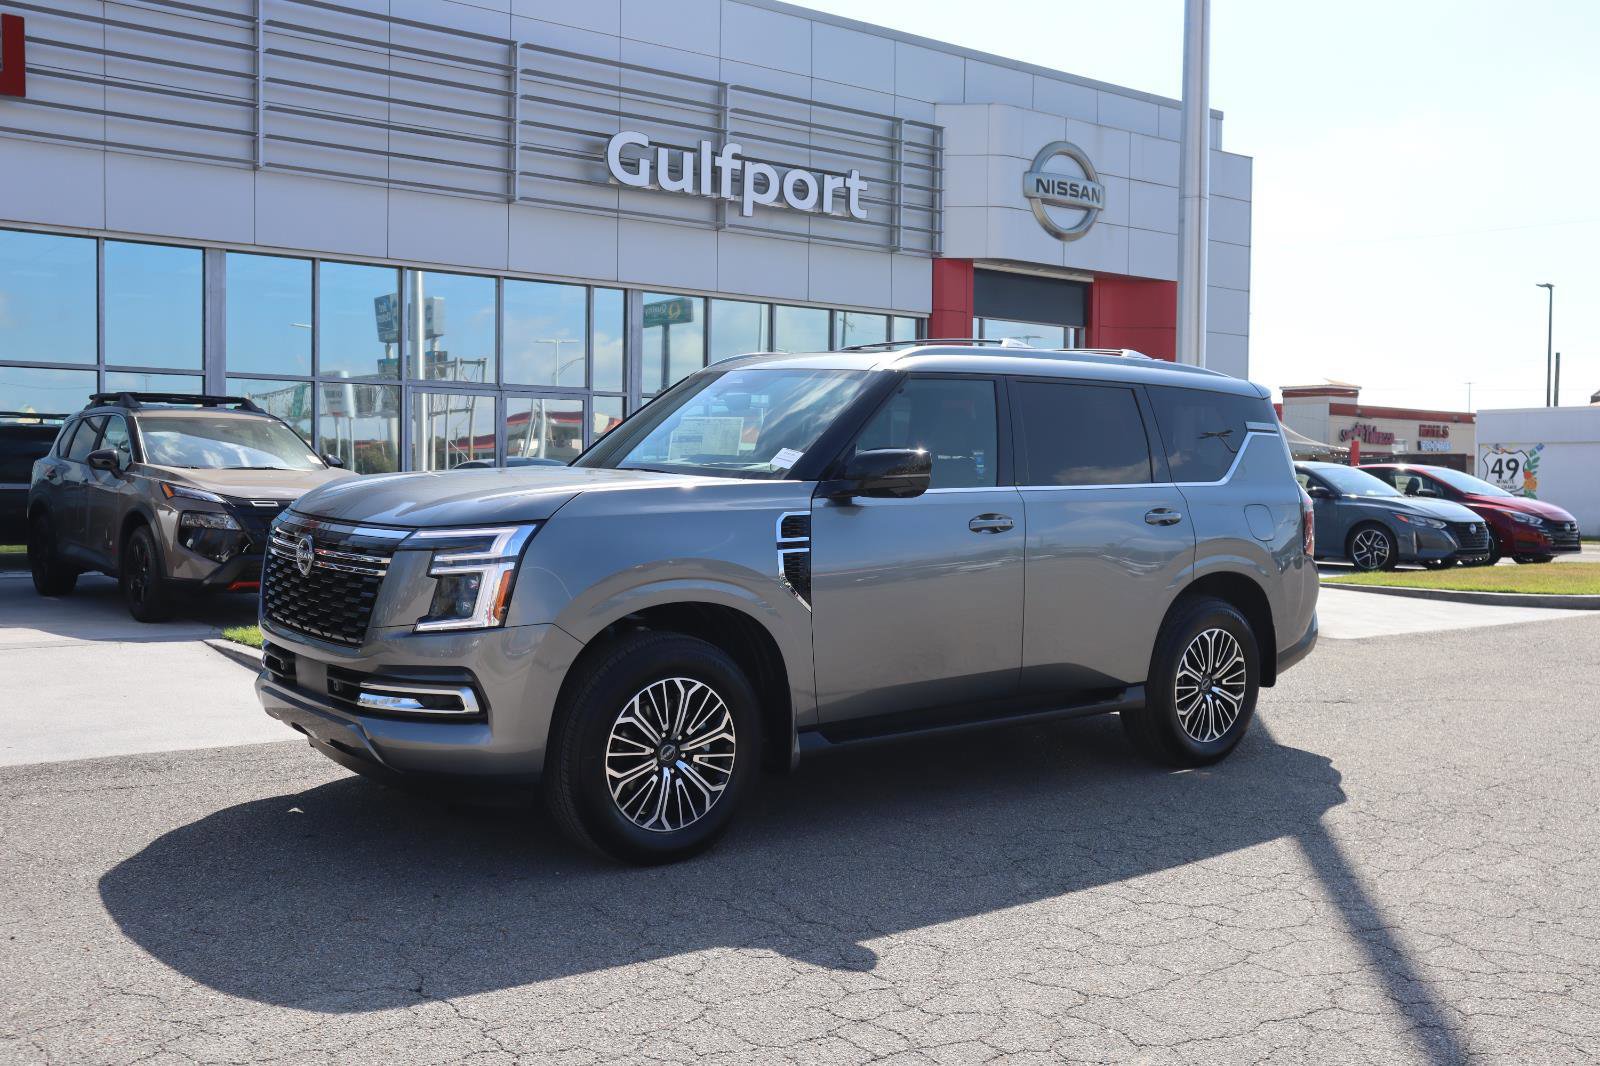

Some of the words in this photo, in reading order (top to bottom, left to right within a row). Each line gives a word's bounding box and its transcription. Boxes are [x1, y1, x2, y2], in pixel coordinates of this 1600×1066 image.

[607, 130, 868, 219] Gulfport
[1035, 178, 1101, 204] NISSAN
[1490, 458, 1519, 479] 49
